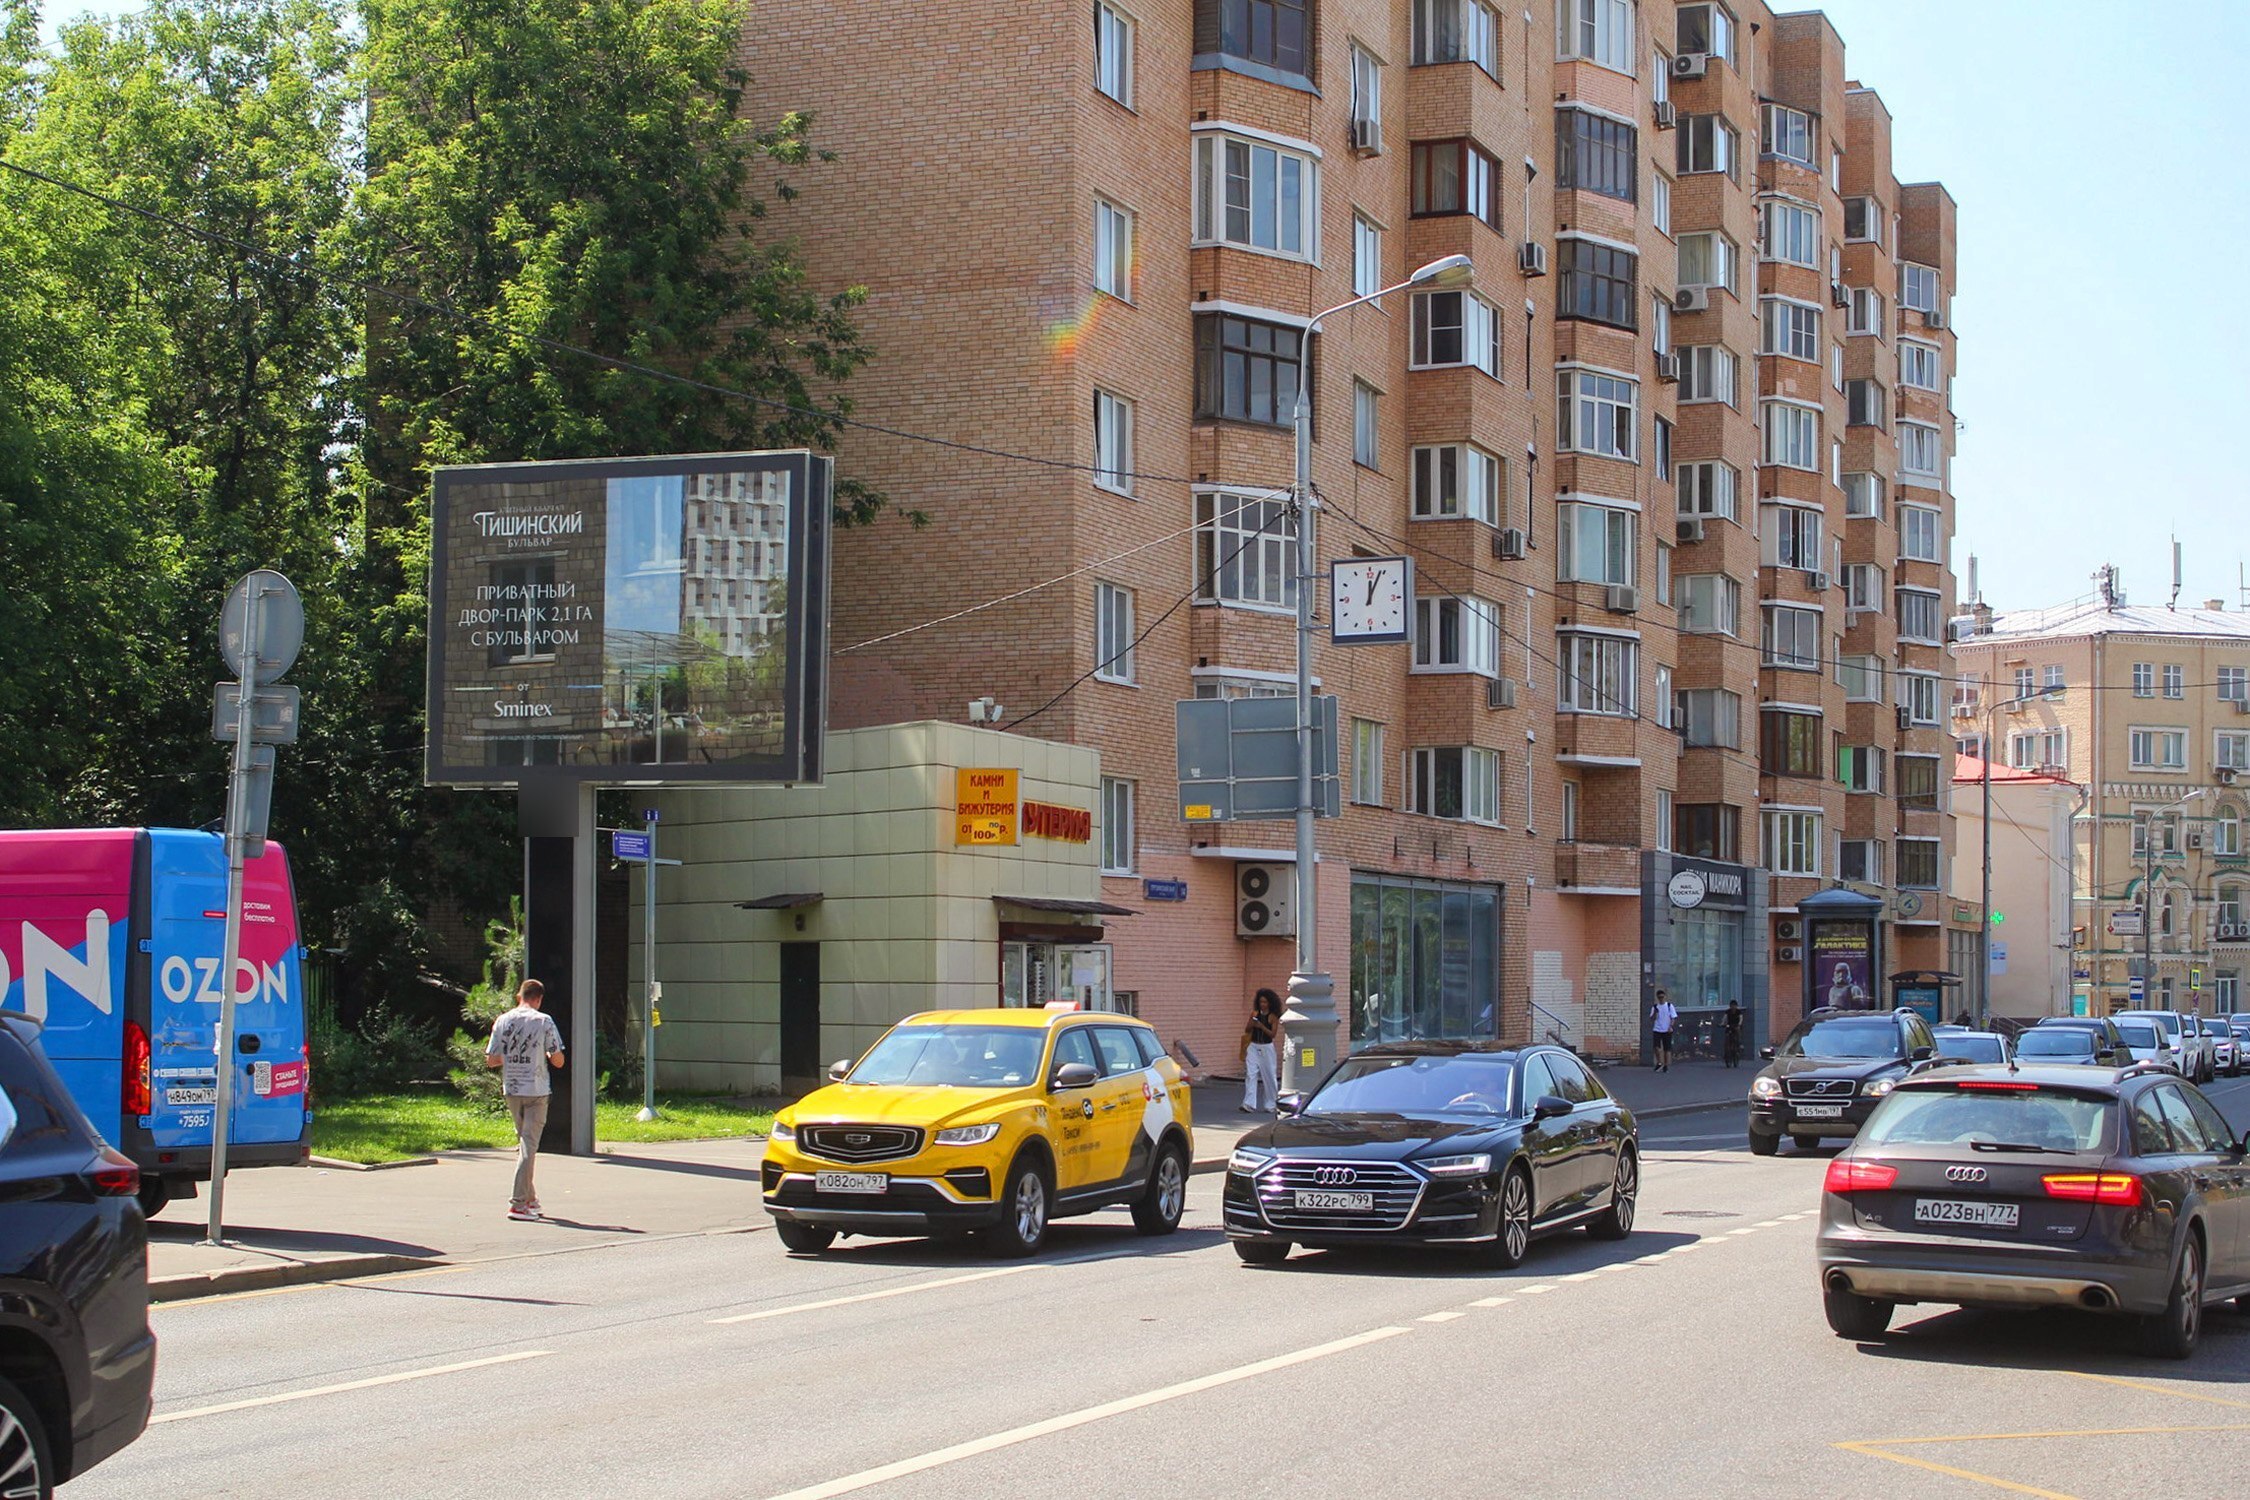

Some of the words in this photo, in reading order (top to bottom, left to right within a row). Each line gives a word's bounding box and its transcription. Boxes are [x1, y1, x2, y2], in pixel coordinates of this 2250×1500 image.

[507, 537, 553, 548] БУЛЬВАР
[1366, 571, 1375, 579] 12
[476, 580, 576, 601] ПРИВАТНЫЙ
[1343, 596, 1350, 604] 9
[1390, 594, 1397, 602] 3
[458, 606, 547, 627] ДВОР-ПАРК
[551, 606, 571, 623] 2,1
[576, 605, 593, 621] ГА
[1367, 618, 1373, 626] 6
[471, 631, 482, 646] С
[486, 629, 580, 646] БУЛЬВАРОМ
[494, 700, 553, 718] Sminex
[970, 774, 1005, 788] КАМНИ
[983, 789, 990, 800] И
[958, 802, 1015, 816] БИЖУТЕРИЯ
[0, 908, 112, 1022] N
[161, 955, 288, 1004] OZON
